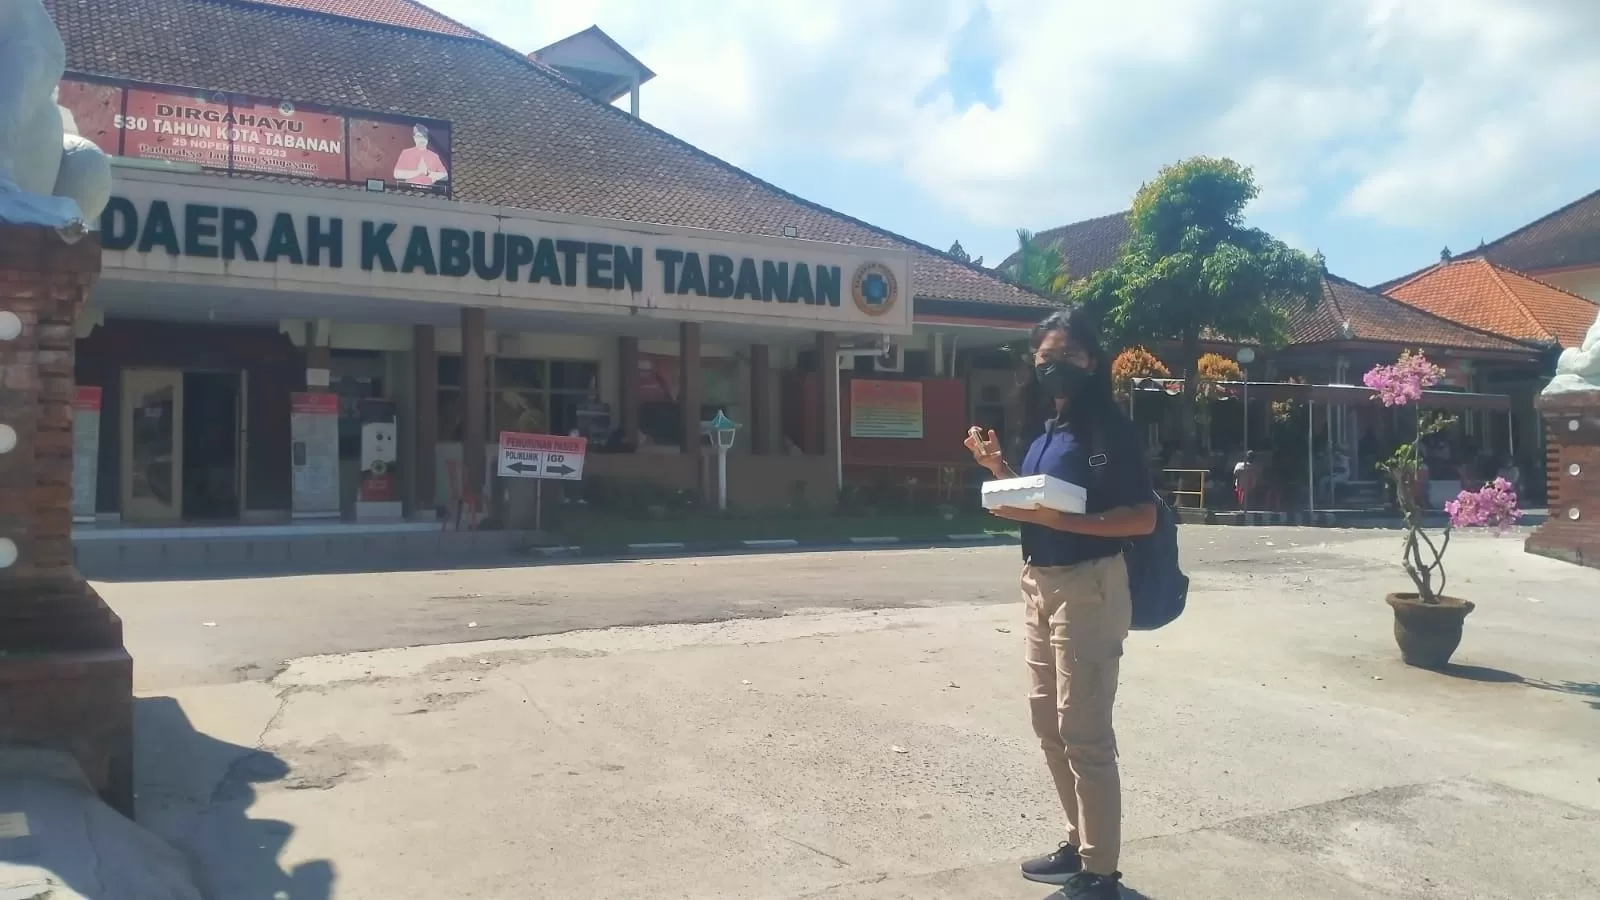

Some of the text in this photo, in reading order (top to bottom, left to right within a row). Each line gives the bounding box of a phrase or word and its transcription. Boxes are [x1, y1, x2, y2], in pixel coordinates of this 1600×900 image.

[156, 103, 304, 132] DIRGAHAYU
[114, 114, 341, 154] 530 TAHUN KOTA TABANAN
[172, 137, 287, 158] 29 NOPEMBER 2023
[101, 196, 343, 268] DAERAH
[361, 220, 643, 292] KABUPATEN
[656, 248, 841, 307] TABANAN
[506, 451, 538, 461] POLIKLINIK
[547, 453, 564, 463] IGD
